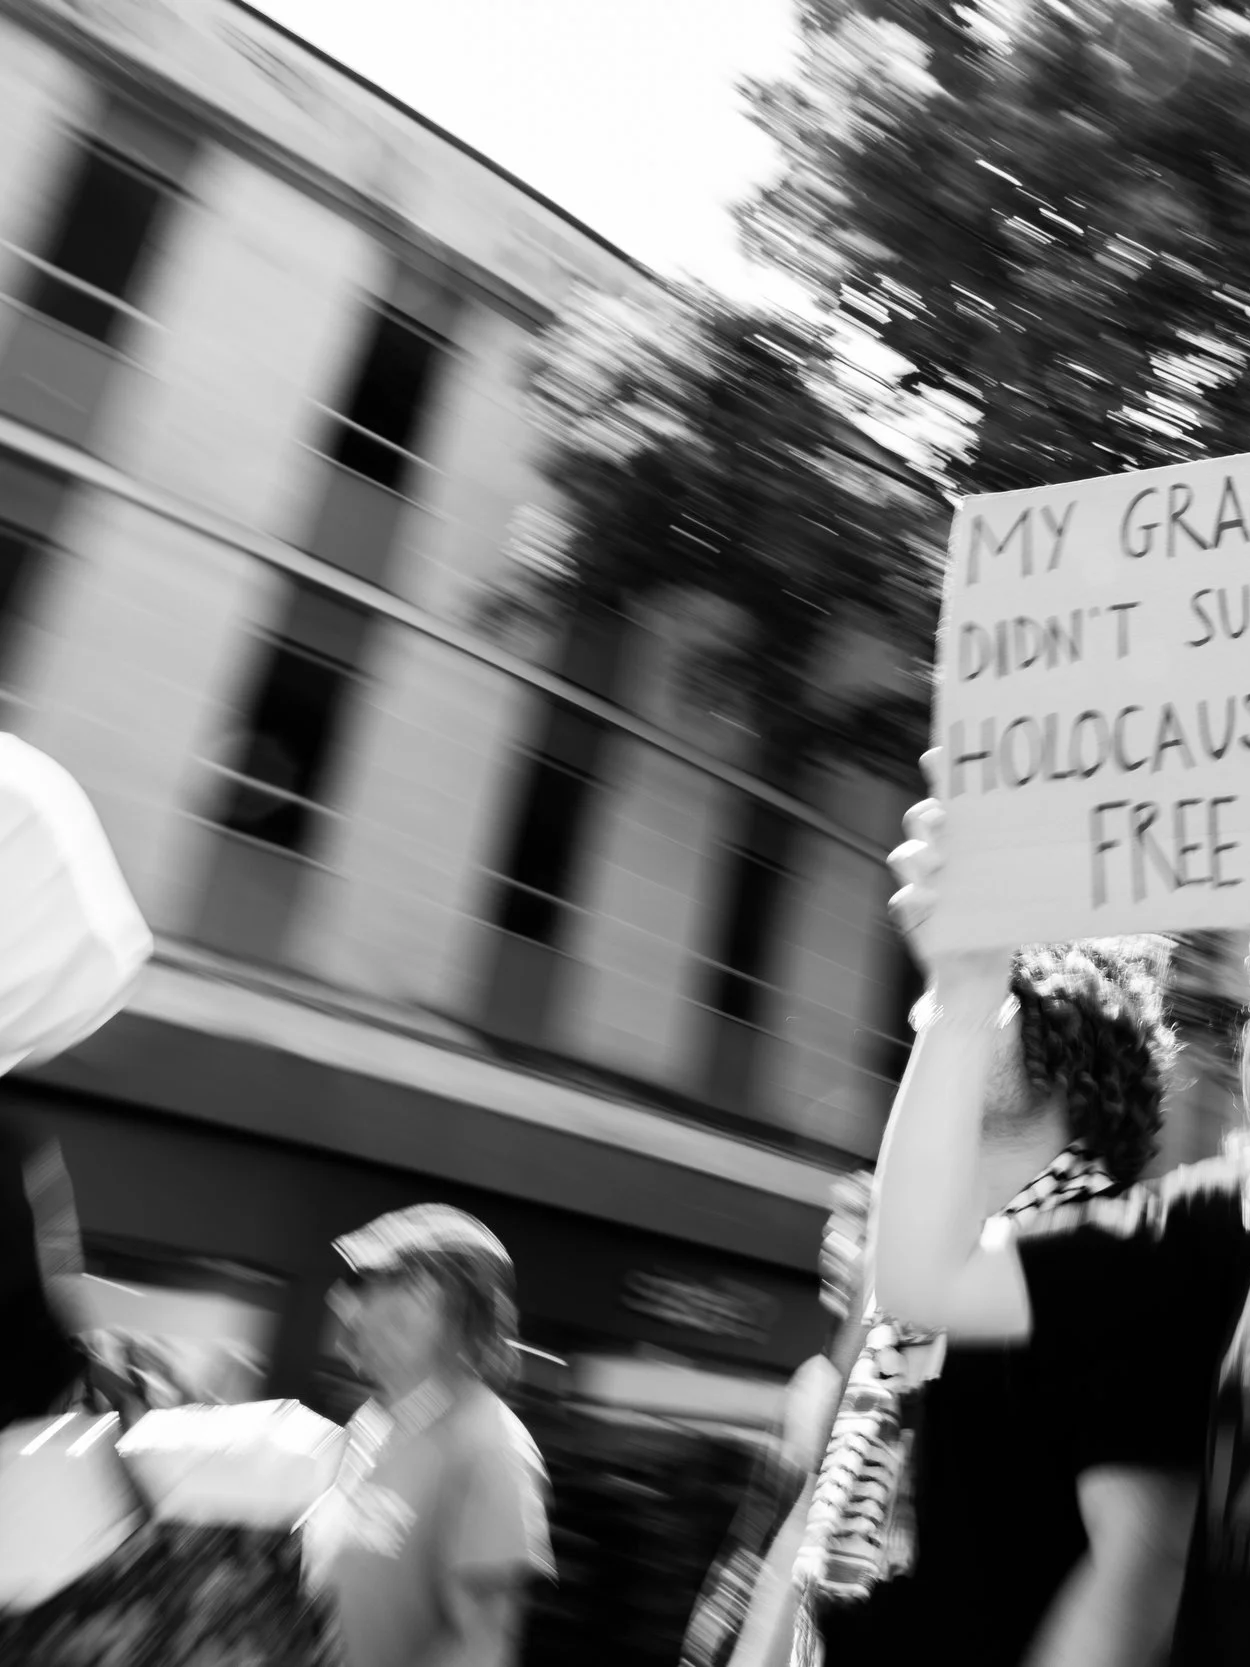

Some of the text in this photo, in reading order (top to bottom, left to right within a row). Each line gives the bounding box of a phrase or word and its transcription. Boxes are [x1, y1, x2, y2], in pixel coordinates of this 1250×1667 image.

[965, 499, 1080, 588] MY
[958, 600, 1142, 682] DIDN'T
[1089, 794, 1245, 910] FREE
